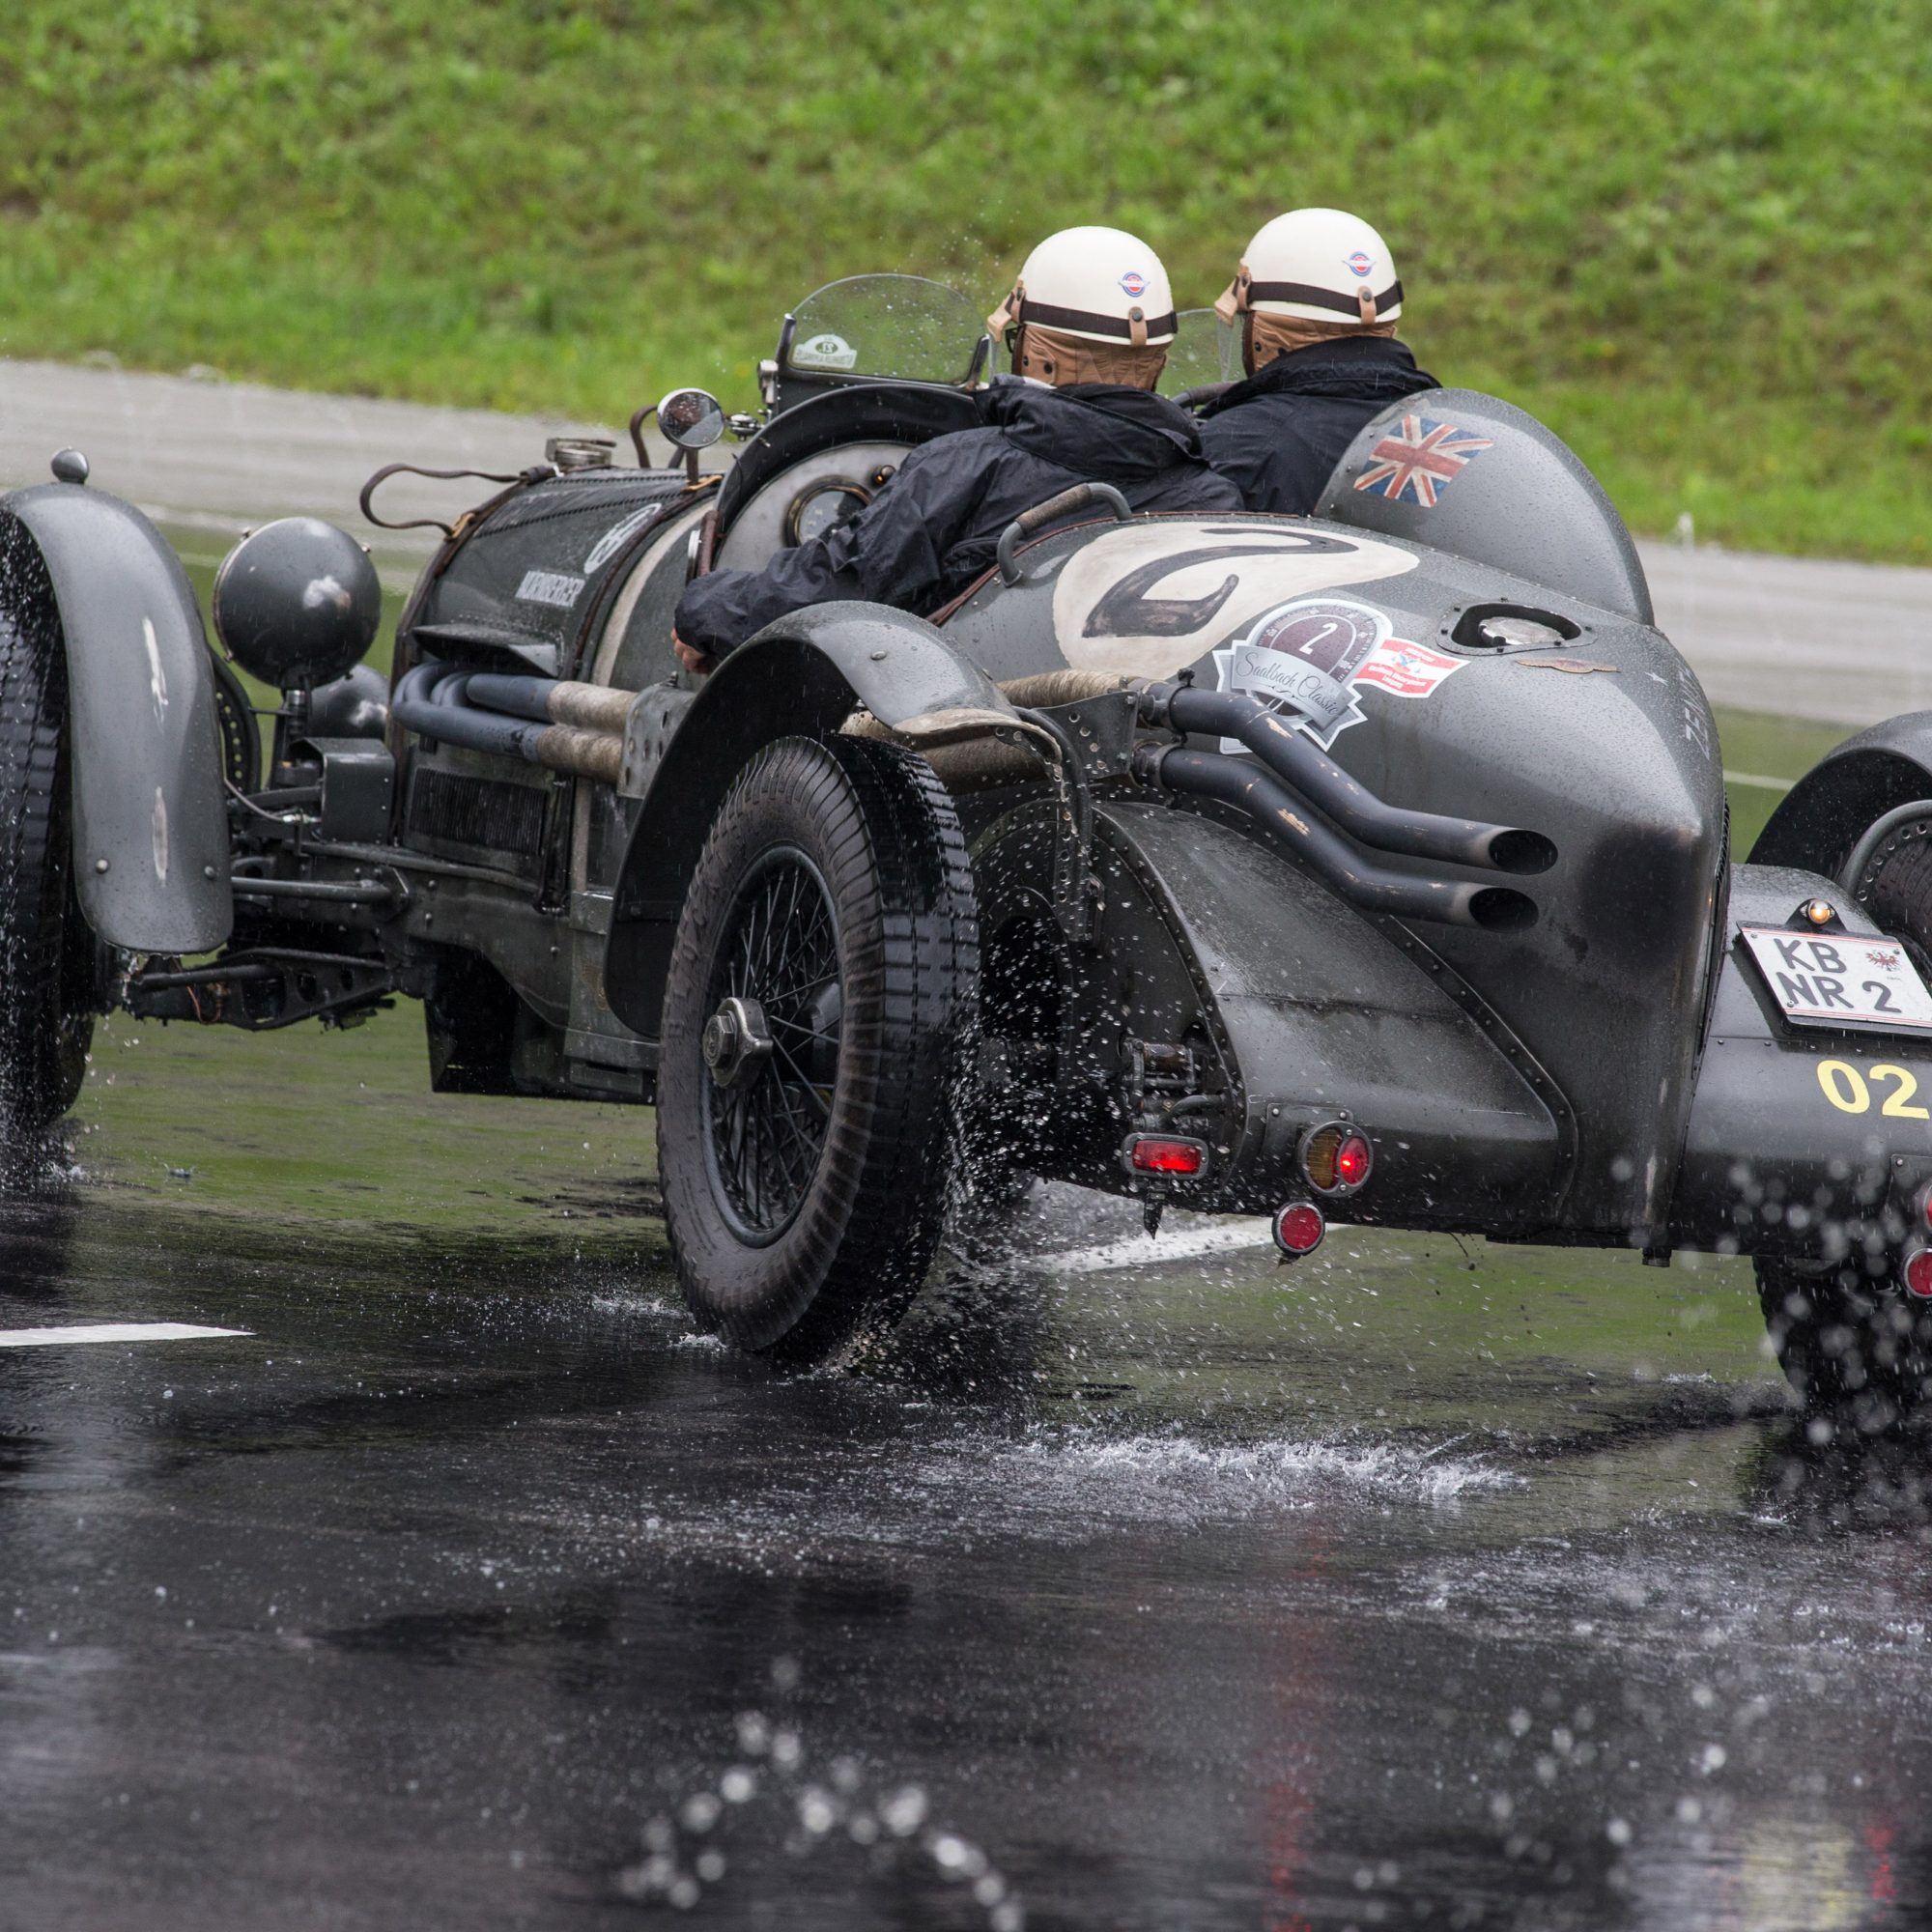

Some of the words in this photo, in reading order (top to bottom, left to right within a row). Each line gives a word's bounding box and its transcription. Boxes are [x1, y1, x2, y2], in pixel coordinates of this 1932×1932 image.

[1082, 527, 1359, 639] 2
[1298, 622, 1338, 655] 2
[1236, 652, 1299, 688] Saalbach
[1297, 673, 1339, 715] Classic
[1774, 937, 1848, 975] KB
[1776, 972, 1855, 1009] NR
[1862, 980, 1902, 1014] 2
[1816, 1060, 1930, 1120] 02
